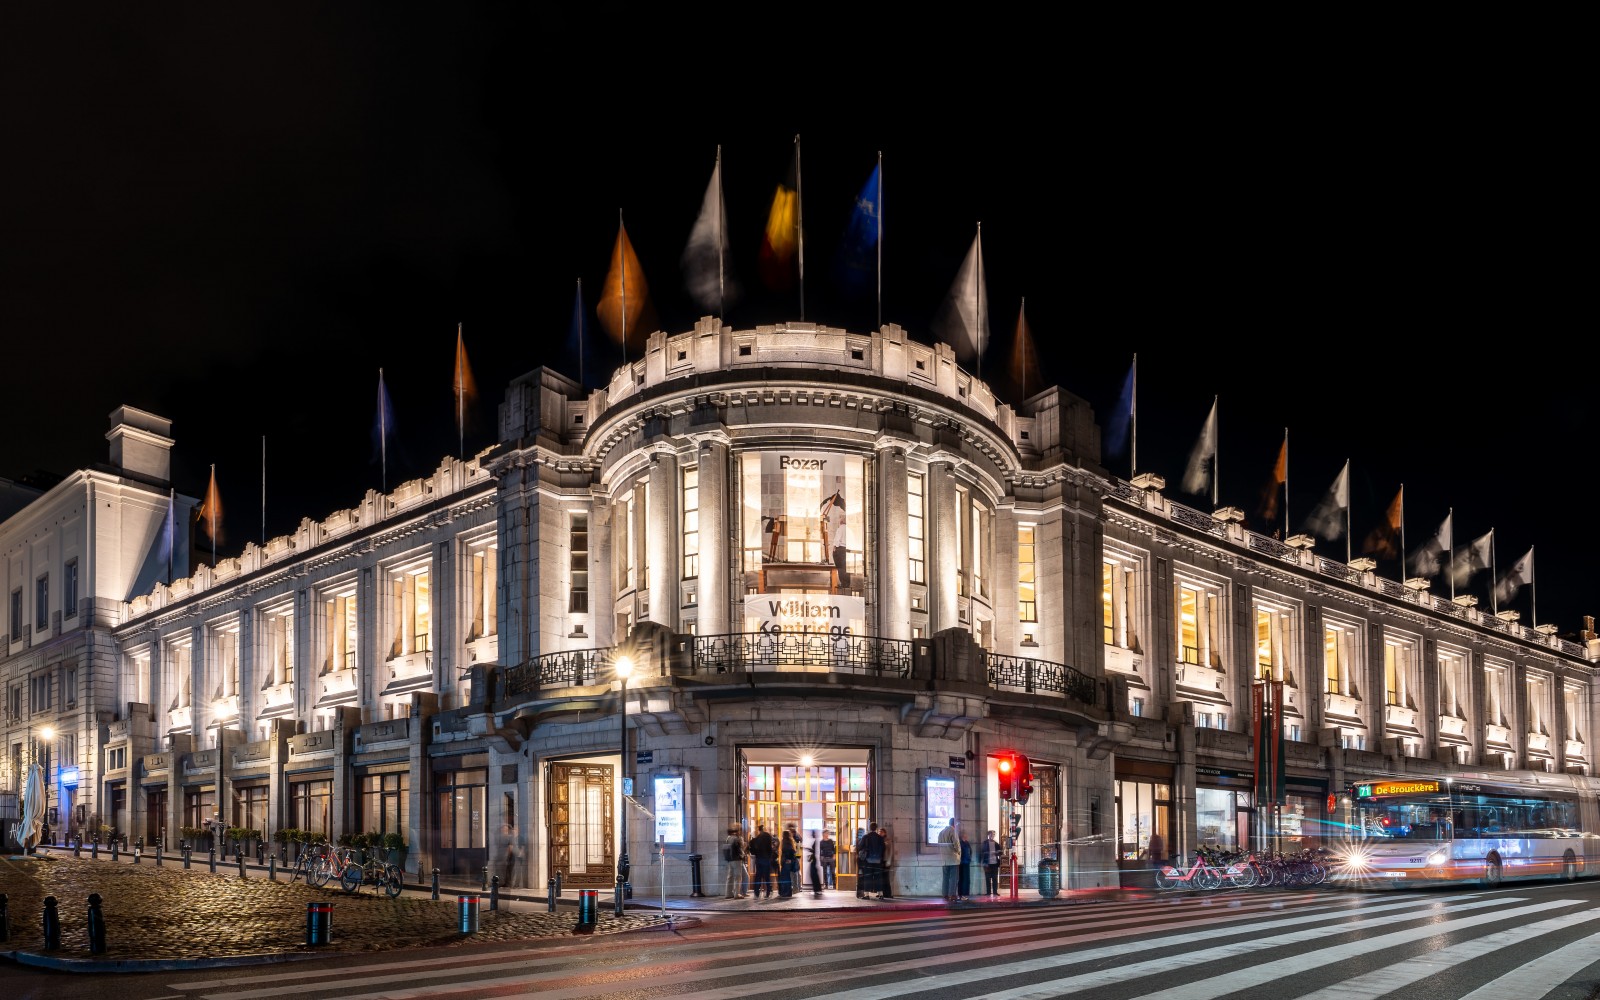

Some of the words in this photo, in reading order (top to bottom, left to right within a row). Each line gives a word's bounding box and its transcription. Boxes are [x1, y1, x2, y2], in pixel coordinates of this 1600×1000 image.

[779, 455, 828, 471] Bozar
[768, 600, 841, 618] William
[756, 620, 855, 641] Kentridge
[1360, 787, 1369, 796] 71
[1376, 787, 1388, 795] De
[1390, 783, 1434, 793] Brouckère
